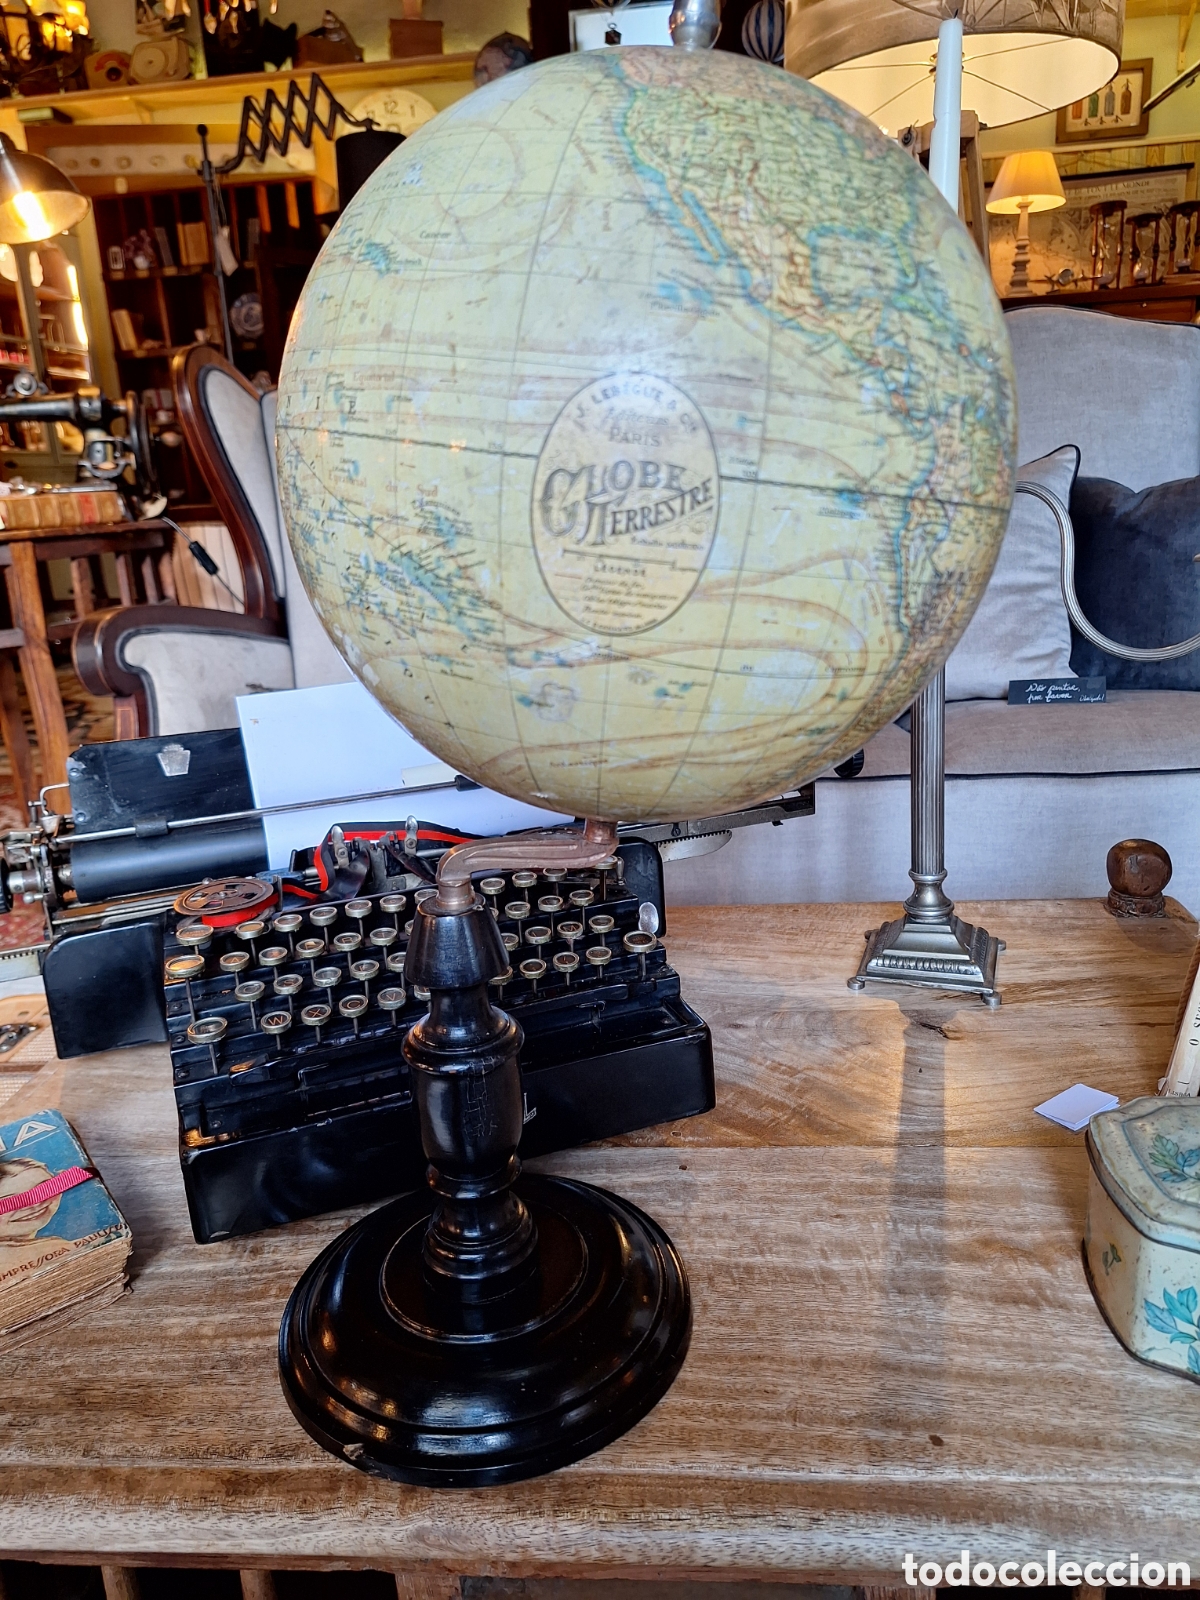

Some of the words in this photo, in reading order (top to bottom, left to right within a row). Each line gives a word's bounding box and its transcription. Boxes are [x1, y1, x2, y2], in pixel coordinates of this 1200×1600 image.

[384, 101, 398, 115] 12
[609, 426, 662, 447] PARIS
[417, 484, 438, 497] Sud
[540, 460, 688, 538] GLOBE
[575, 478, 715, 546] TERRESTRE
